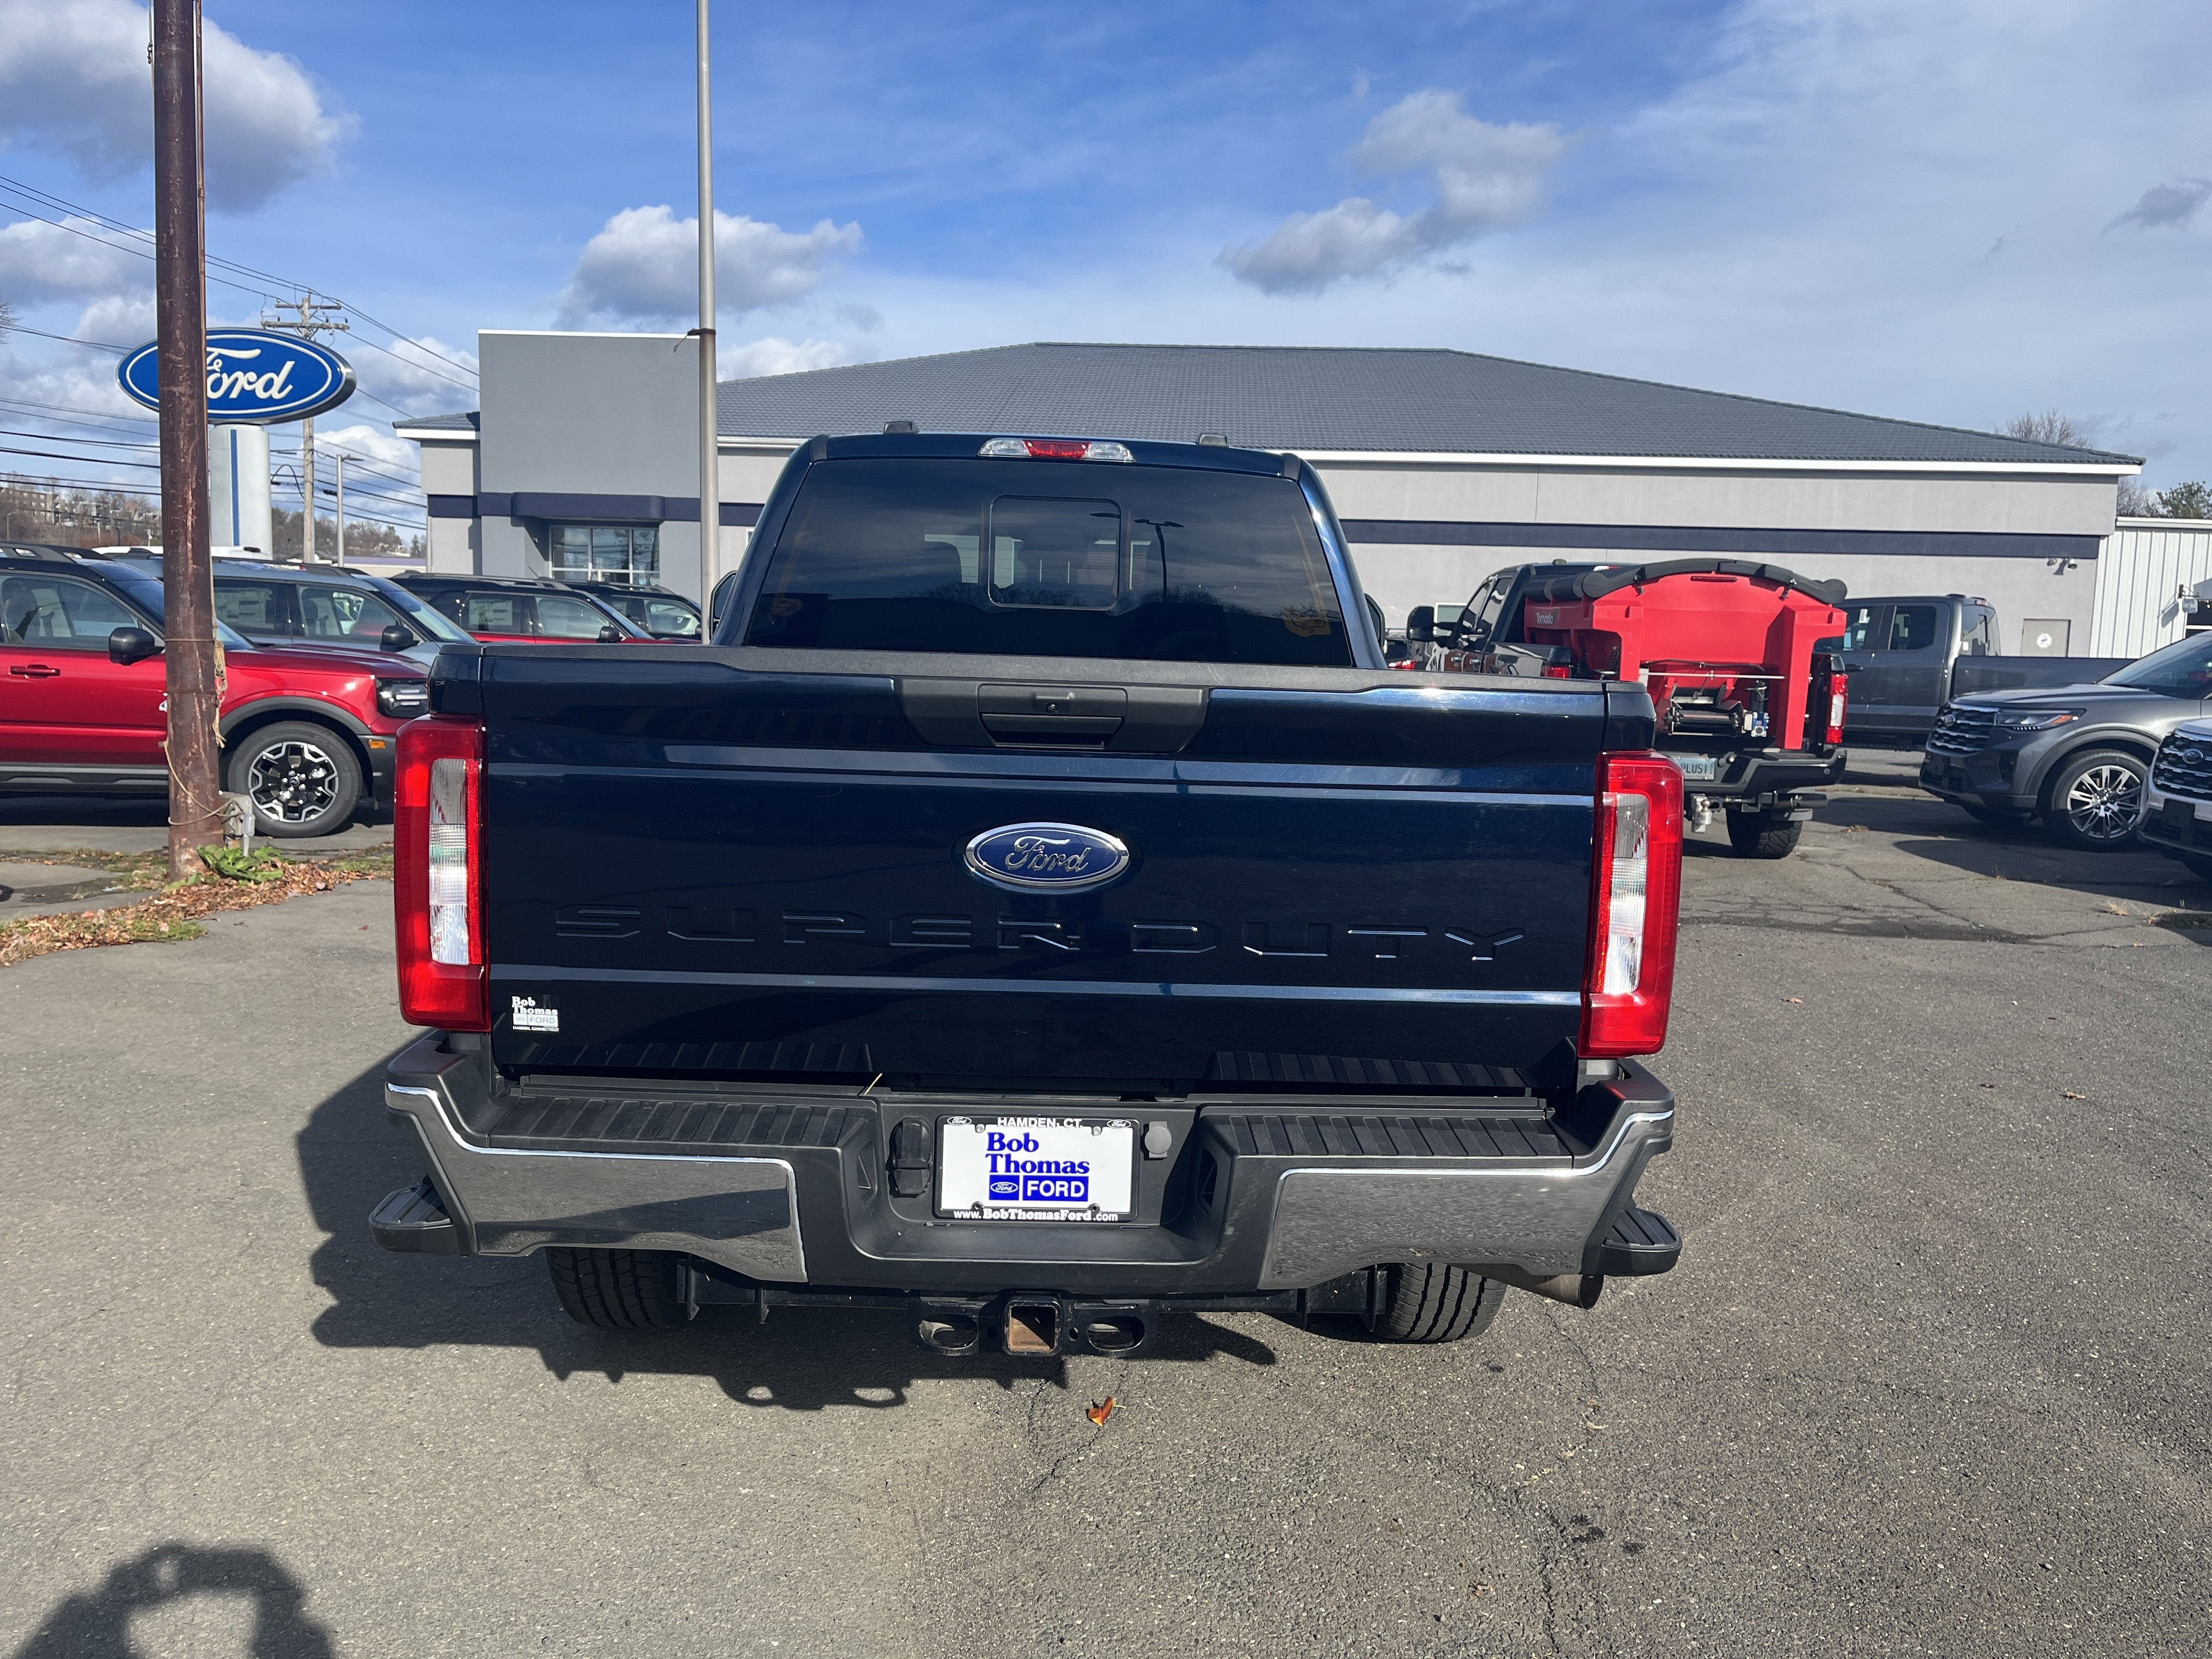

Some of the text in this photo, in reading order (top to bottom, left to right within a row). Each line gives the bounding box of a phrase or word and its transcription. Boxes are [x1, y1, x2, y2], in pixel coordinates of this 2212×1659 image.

[1005, 836, 1091, 873] Ford
[556, 904, 1525, 961] SUPER DUTY
[511, 1005, 558, 1015] Thomas
[512, 996, 535, 1006] Bob
[986, 1132, 1040, 1153] Bob
[985, 1153, 1090, 1175] Thomas
[995, 1183, 1013, 1192] Ford
[1027, 1180, 1085, 1198] FORD
